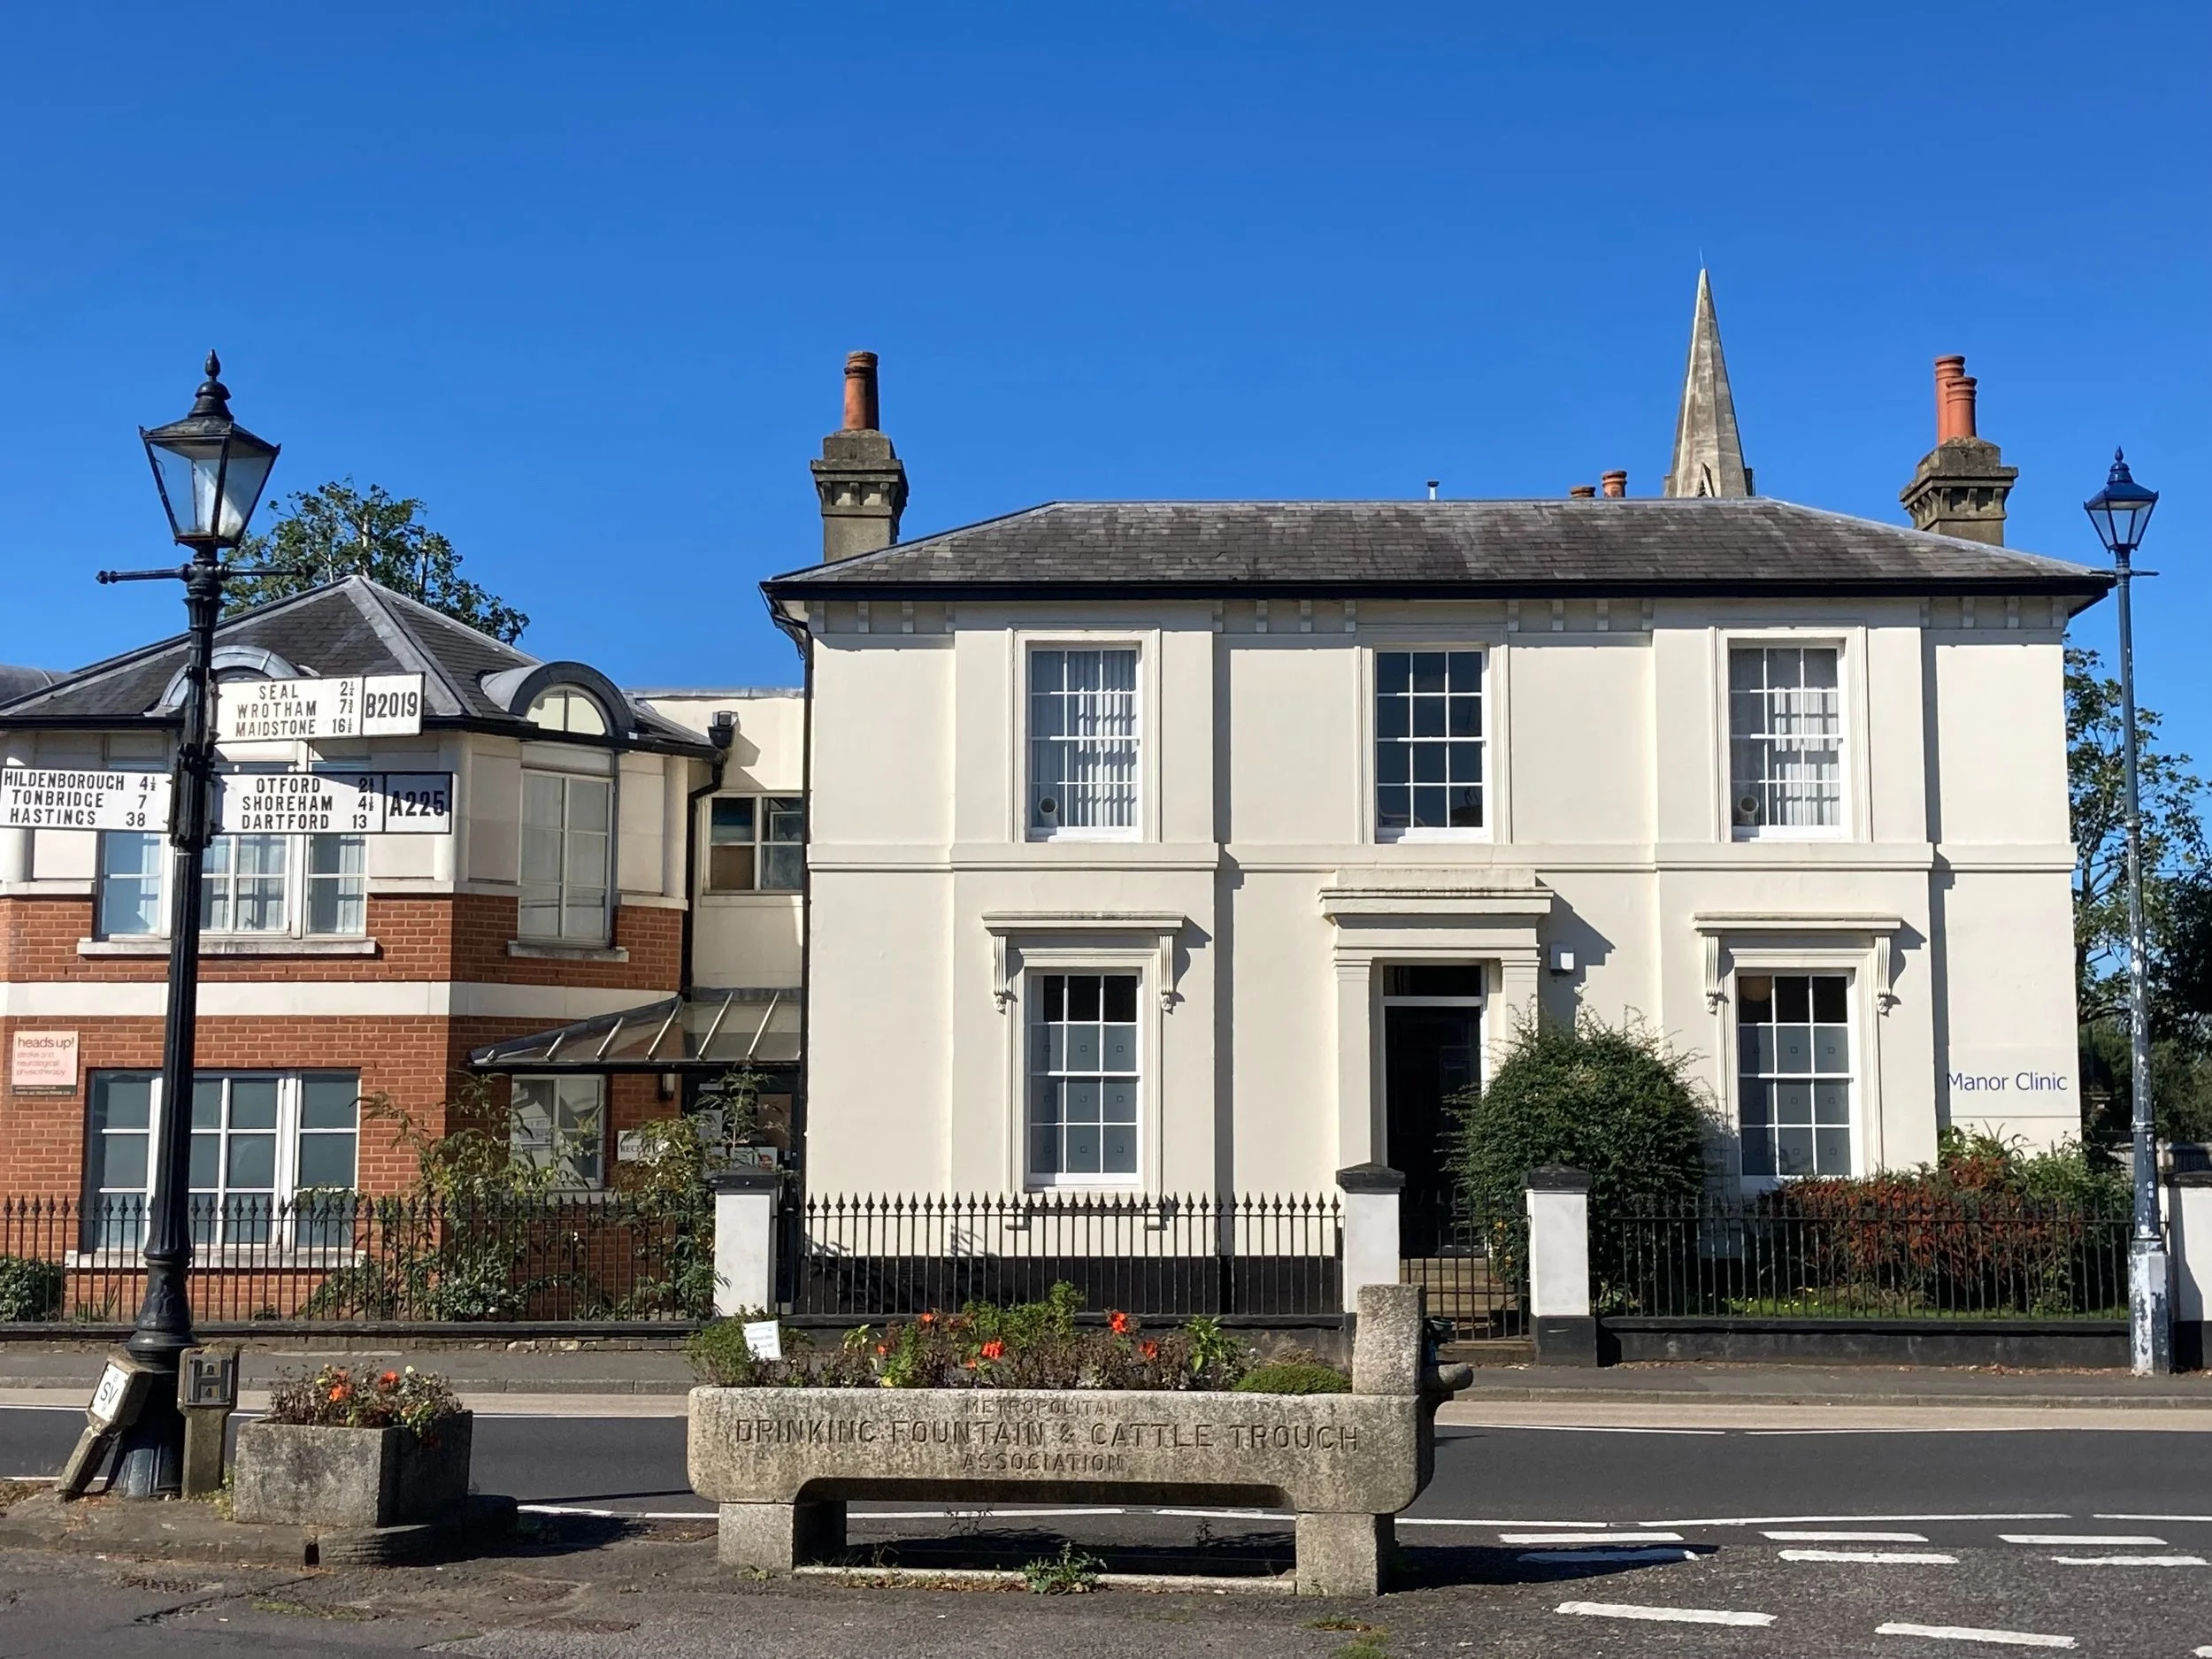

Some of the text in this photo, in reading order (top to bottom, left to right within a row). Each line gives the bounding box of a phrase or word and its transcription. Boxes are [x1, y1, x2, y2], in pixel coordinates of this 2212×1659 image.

[259, 684, 299, 700] SEAL
[237, 700, 317, 718] WROTHAM
[365, 692, 419, 718] B2019
[235, 719, 316, 737] MAIDSTONE
[4, 771, 125, 791] HILDENBOROUGH
[256, 778, 320, 794] OTFORD
[12, 788, 148, 810] TONBRIDGE 7
[242, 795, 333, 811] SHOREHAM
[389, 790, 445, 818] A225
[10, 808, 146, 827] HASTINGS 38
[242, 814, 367, 830] DARTFORD 13
[18, 1036, 75, 1050] heads up!
[1947, 1071, 2068, 1092] Manor Clinic
[100, 1381, 119, 1405] SV
[964, 1397, 1119, 1416] METROPOLITAN
[735, 1419, 1359, 1451] DRINKING FOUNTAIN & CATTLE TROUGH
[963, 1453, 1123, 1472] ASSOCIATION
